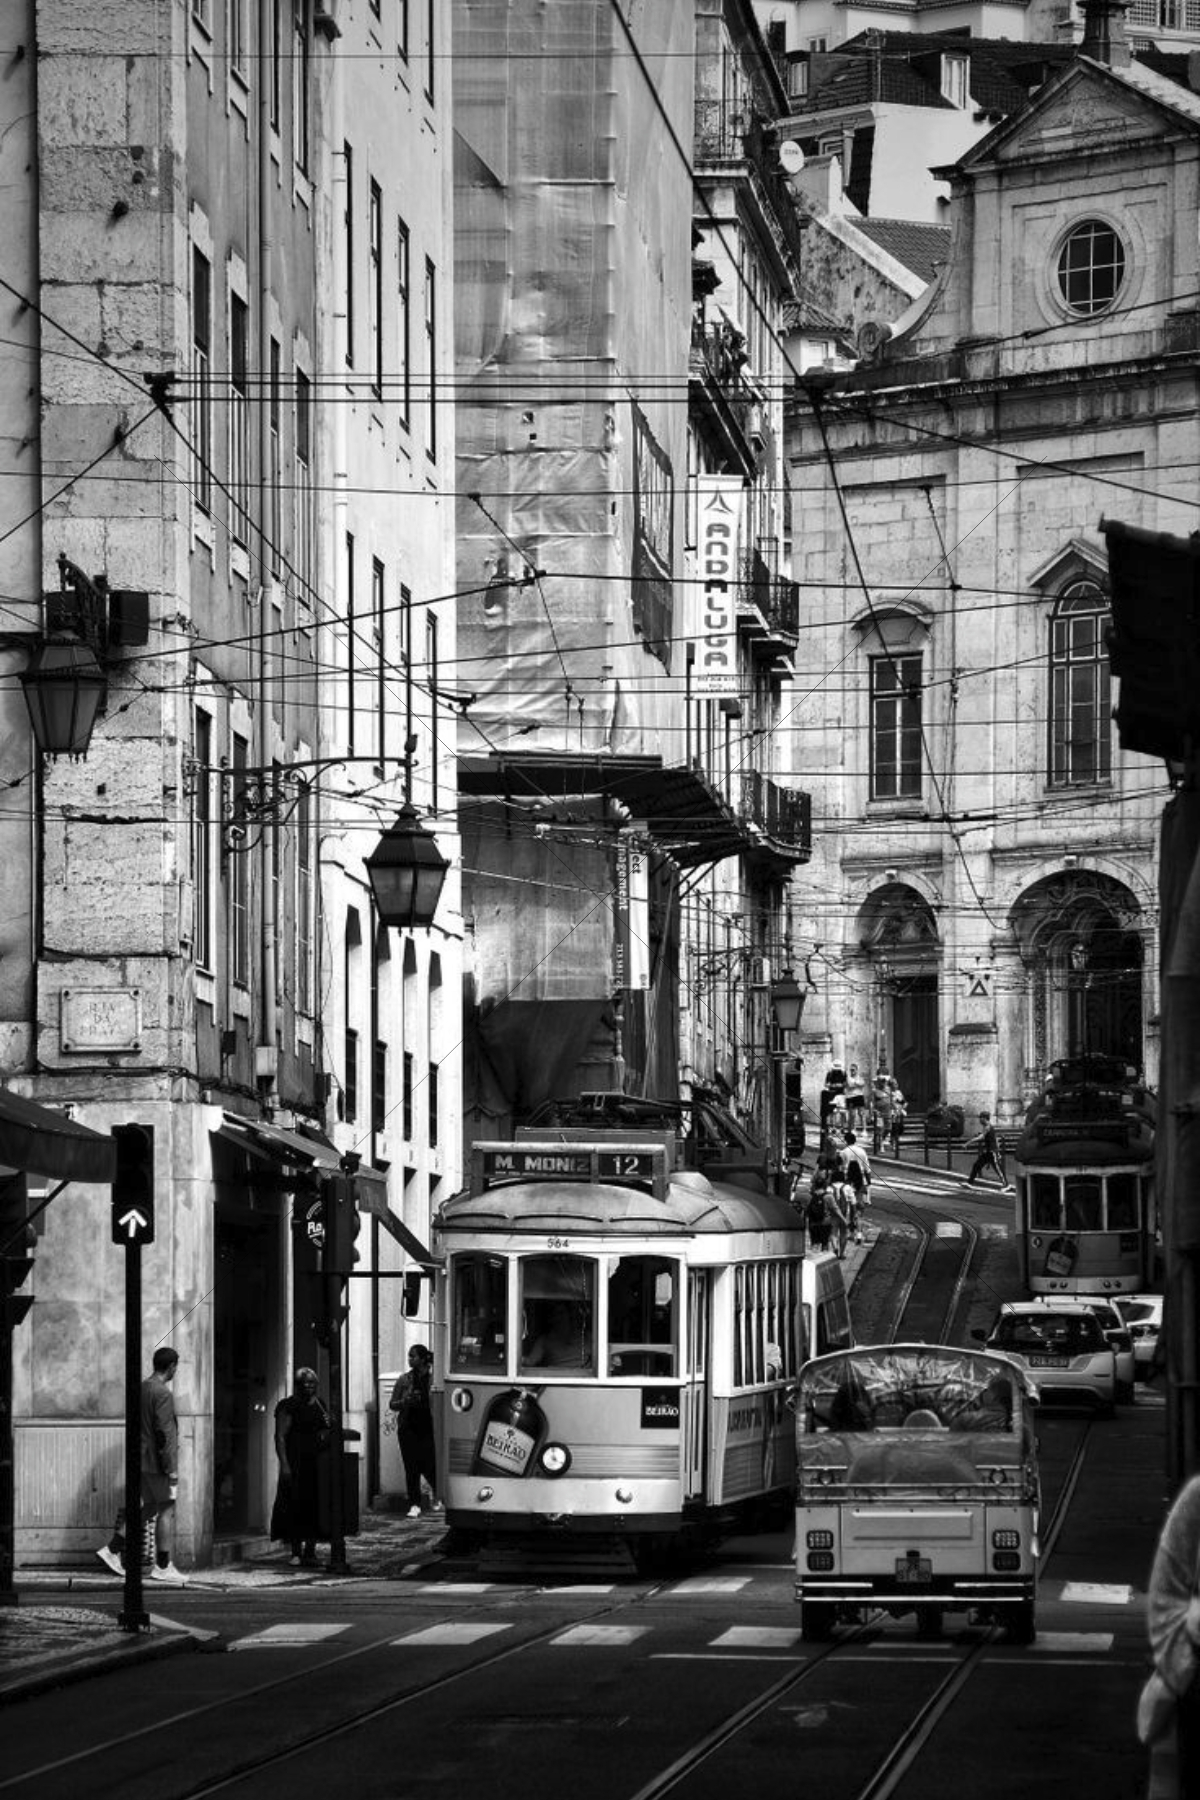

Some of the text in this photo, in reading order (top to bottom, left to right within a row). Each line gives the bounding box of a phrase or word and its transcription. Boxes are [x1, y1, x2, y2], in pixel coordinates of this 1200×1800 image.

[524, 1156, 590, 1172] MONIZ
[613, 1156, 639, 1174] 12
[547, 1238, 569, 1249] 564
[486, 1433, 526, 1460] BEIRÃO
